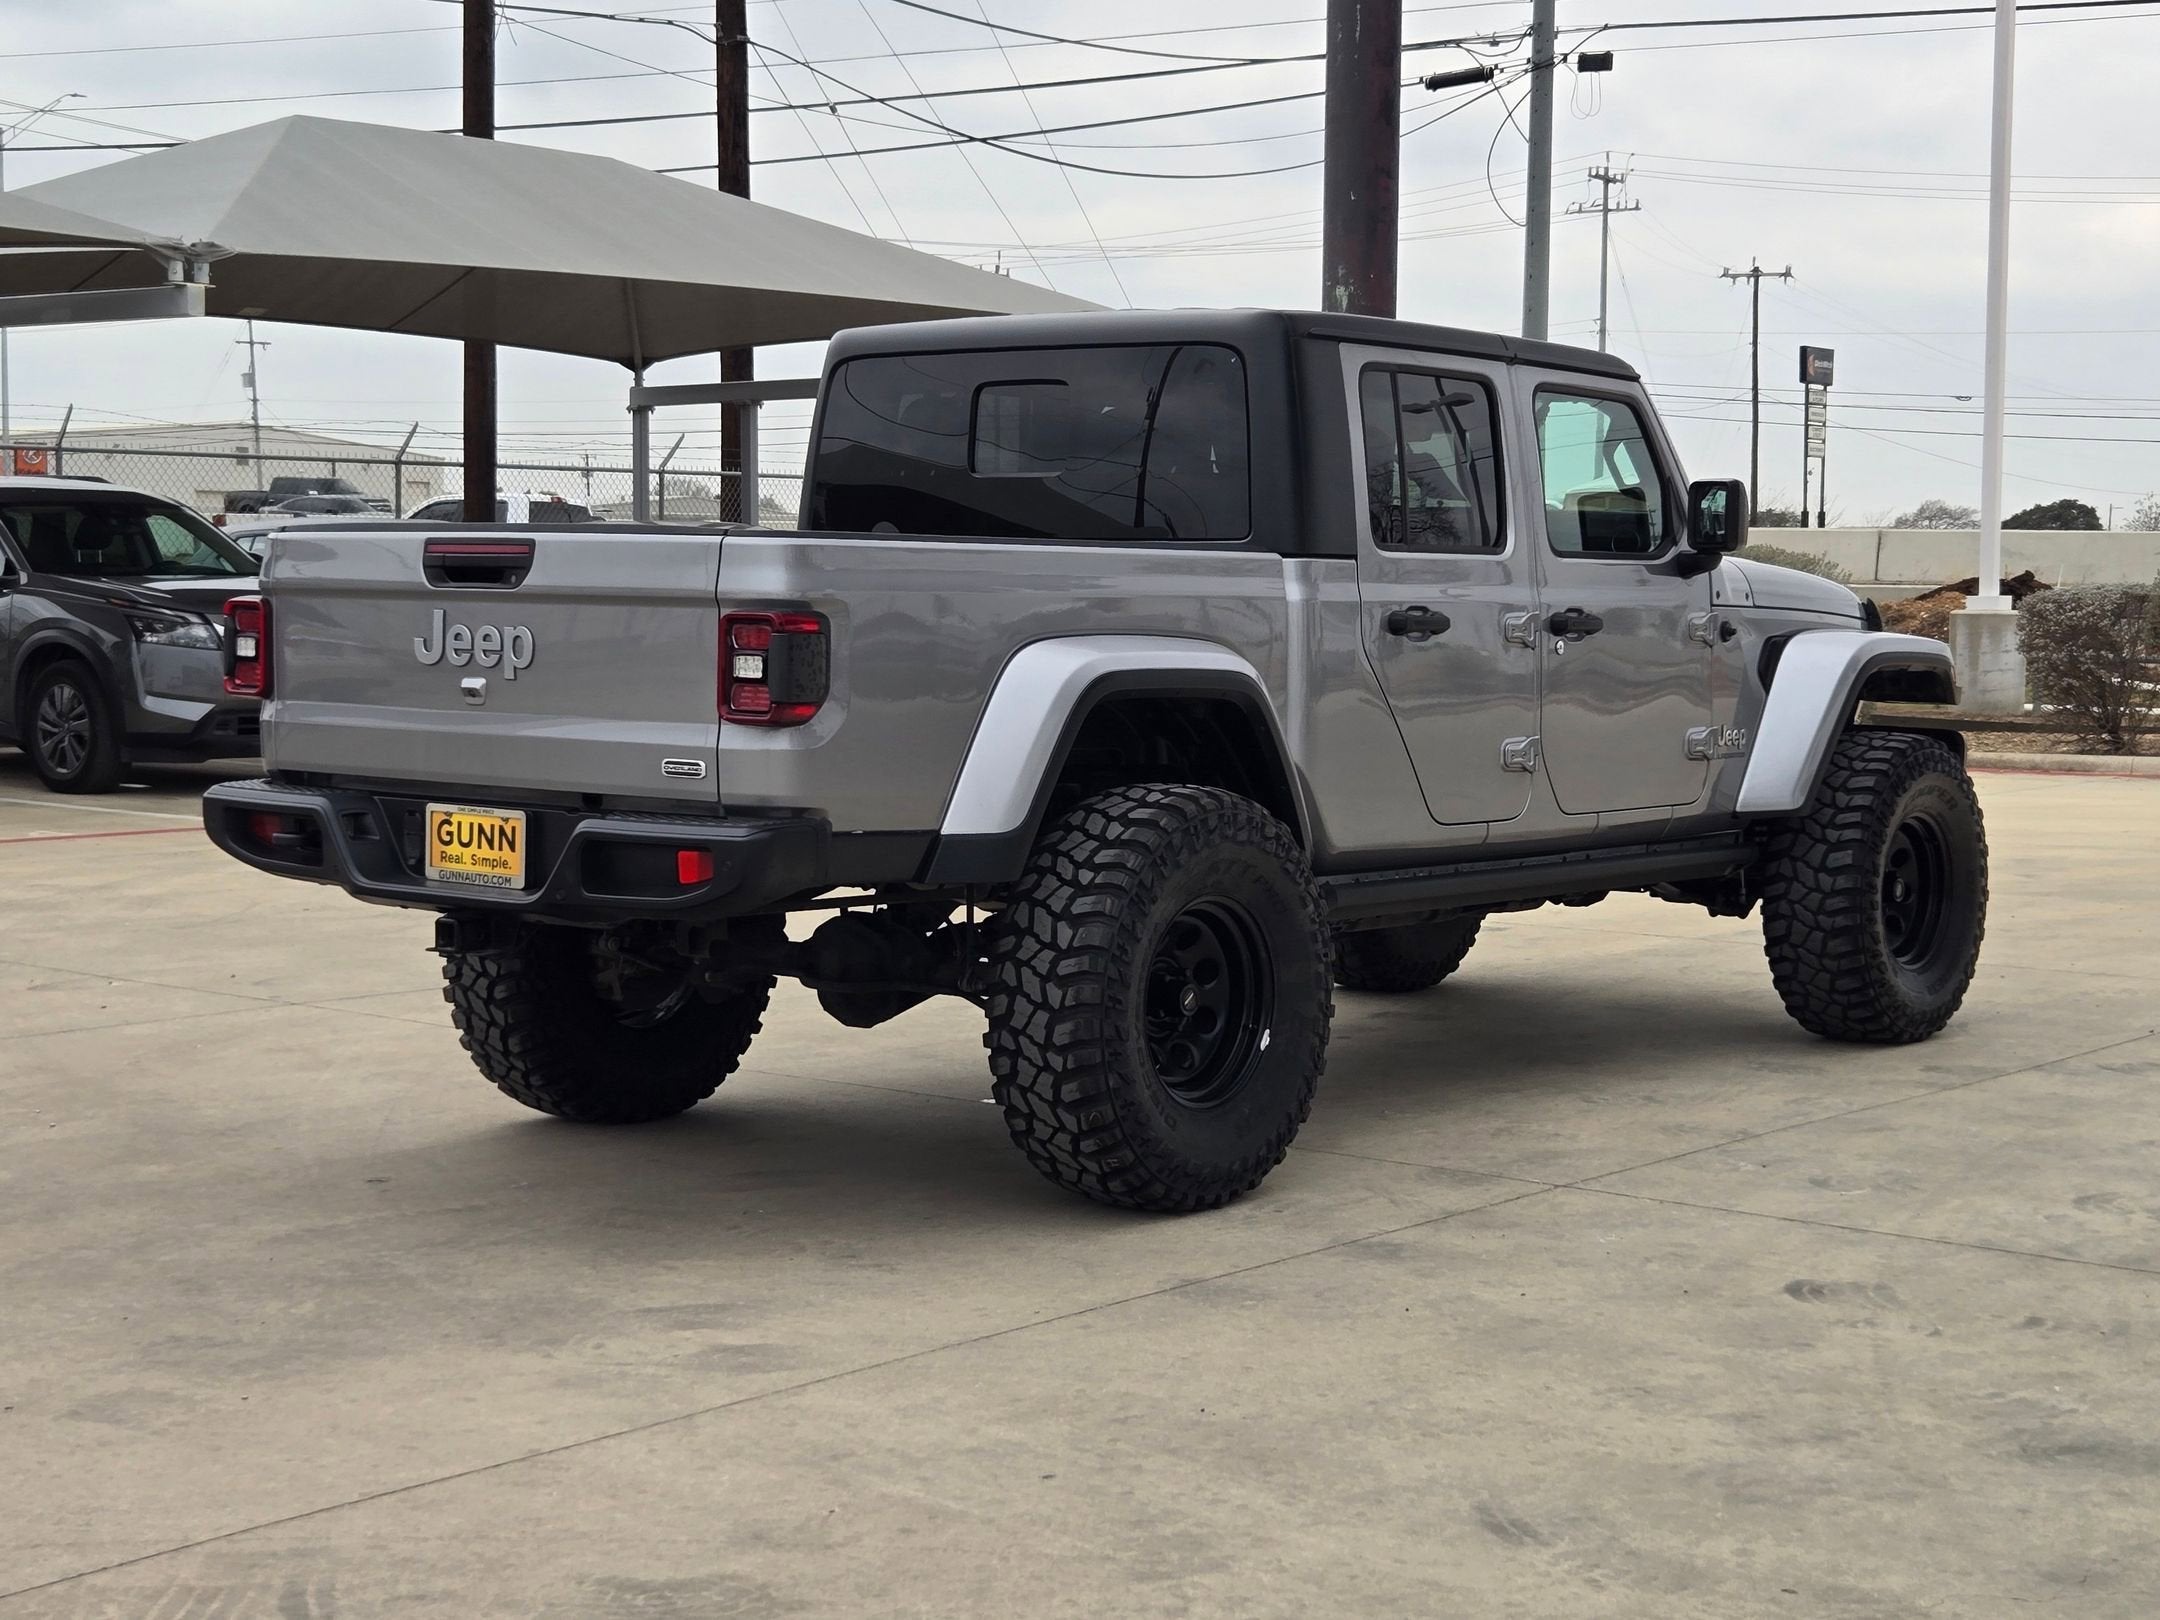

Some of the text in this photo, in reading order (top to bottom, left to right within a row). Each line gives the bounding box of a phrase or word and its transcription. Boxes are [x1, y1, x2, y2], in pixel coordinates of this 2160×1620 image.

[414, 608, 534, 681] Jeep
[1718, 725, 1746, 750] Jeep
[437, 818, 516, 853] GUNN
[440, 850, 467, 865] Real.
[439, 870, 512, 886] GUNNAUTO.COM
